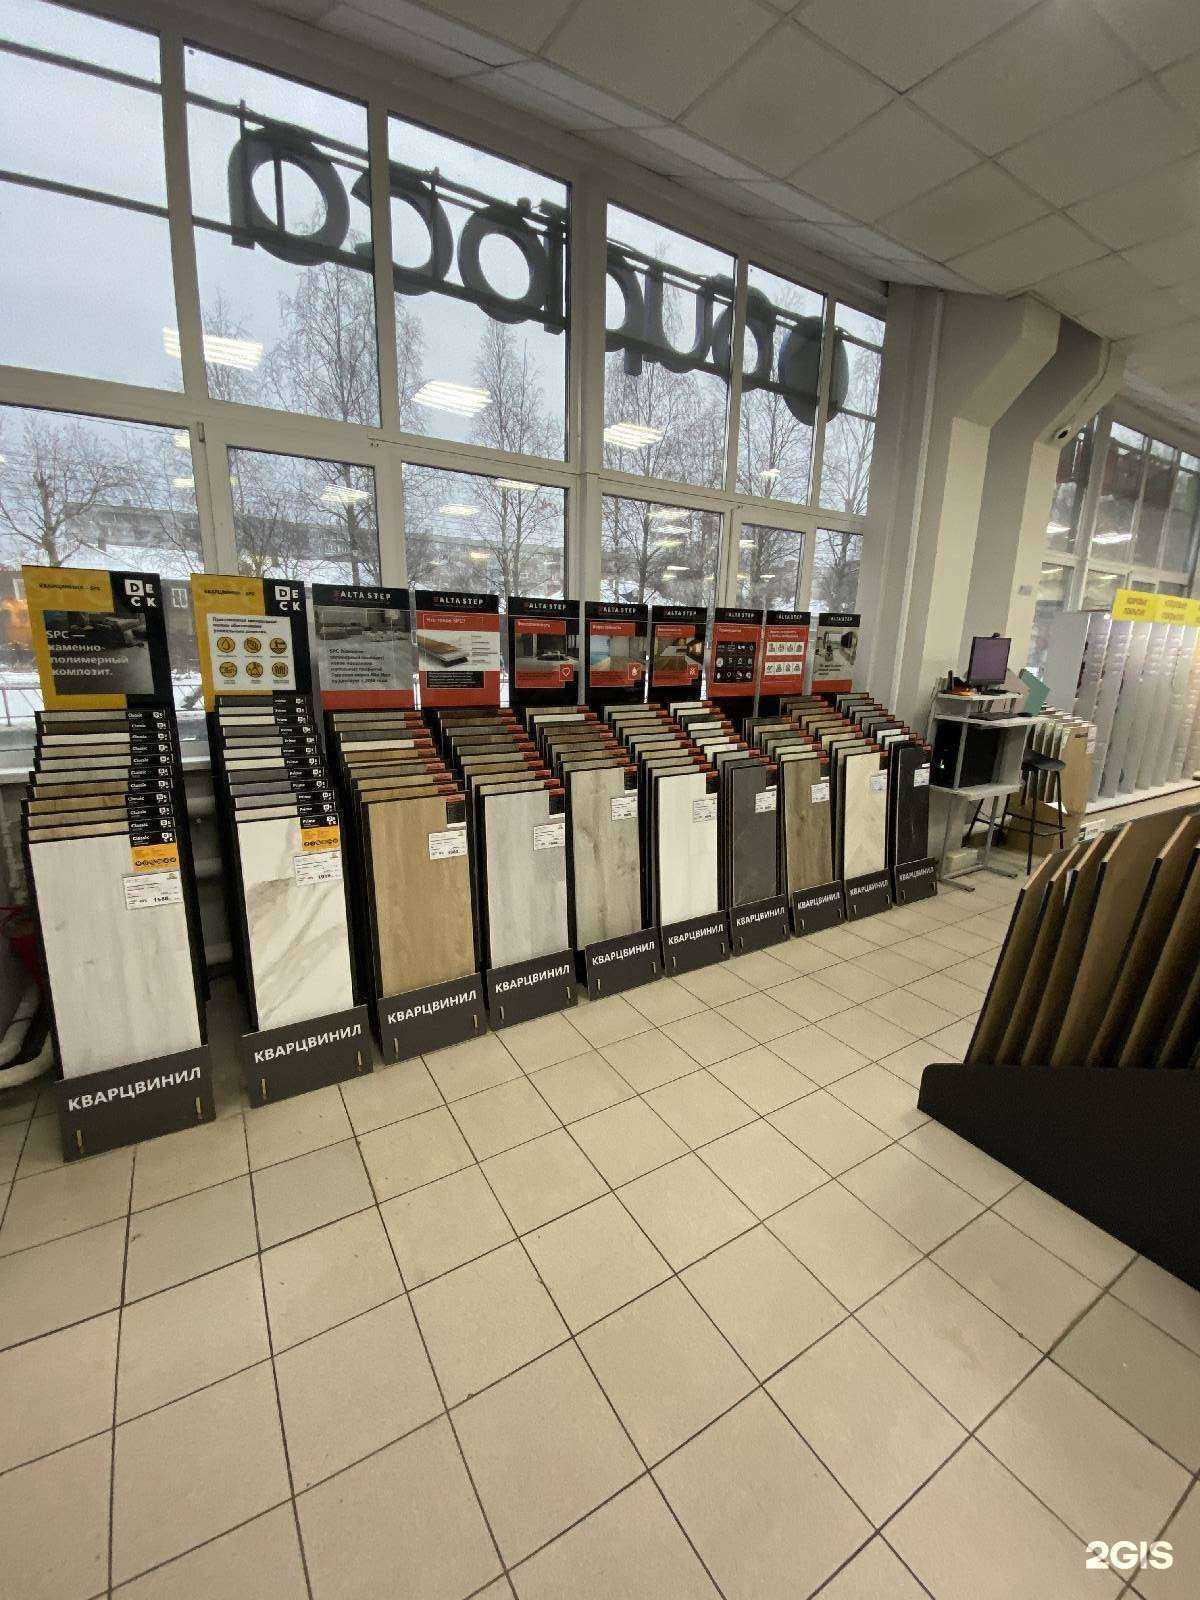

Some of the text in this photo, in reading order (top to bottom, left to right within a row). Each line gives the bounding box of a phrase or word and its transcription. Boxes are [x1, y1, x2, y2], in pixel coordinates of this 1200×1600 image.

[46, 630, 70, 639] SPC
[899, 865, 935, 882] КВАРЦВИНИЛ
[848, 878, 889, 896] КВАРЦВИНИЛ
[797, 891, 841, 910] КВАРЦВИНИЛ
[736, 906, 785, 927] КВАРЦВИНИЛ
[667, 923, 724, 945] КВАРЦВИНИЛ
[591, 941, 655, 966] КВАРЦВИНИЛ
[494, 964, 570, 994] КВАРЦВИНИЛ
[387, 989, 477, 1025] КВАРЦВИНИЛ
[254, 1023, 362, 1064] КВАРЦВИНИЛ
[67, 1066, 201, 1112] КВАРЦВИНИЛ
